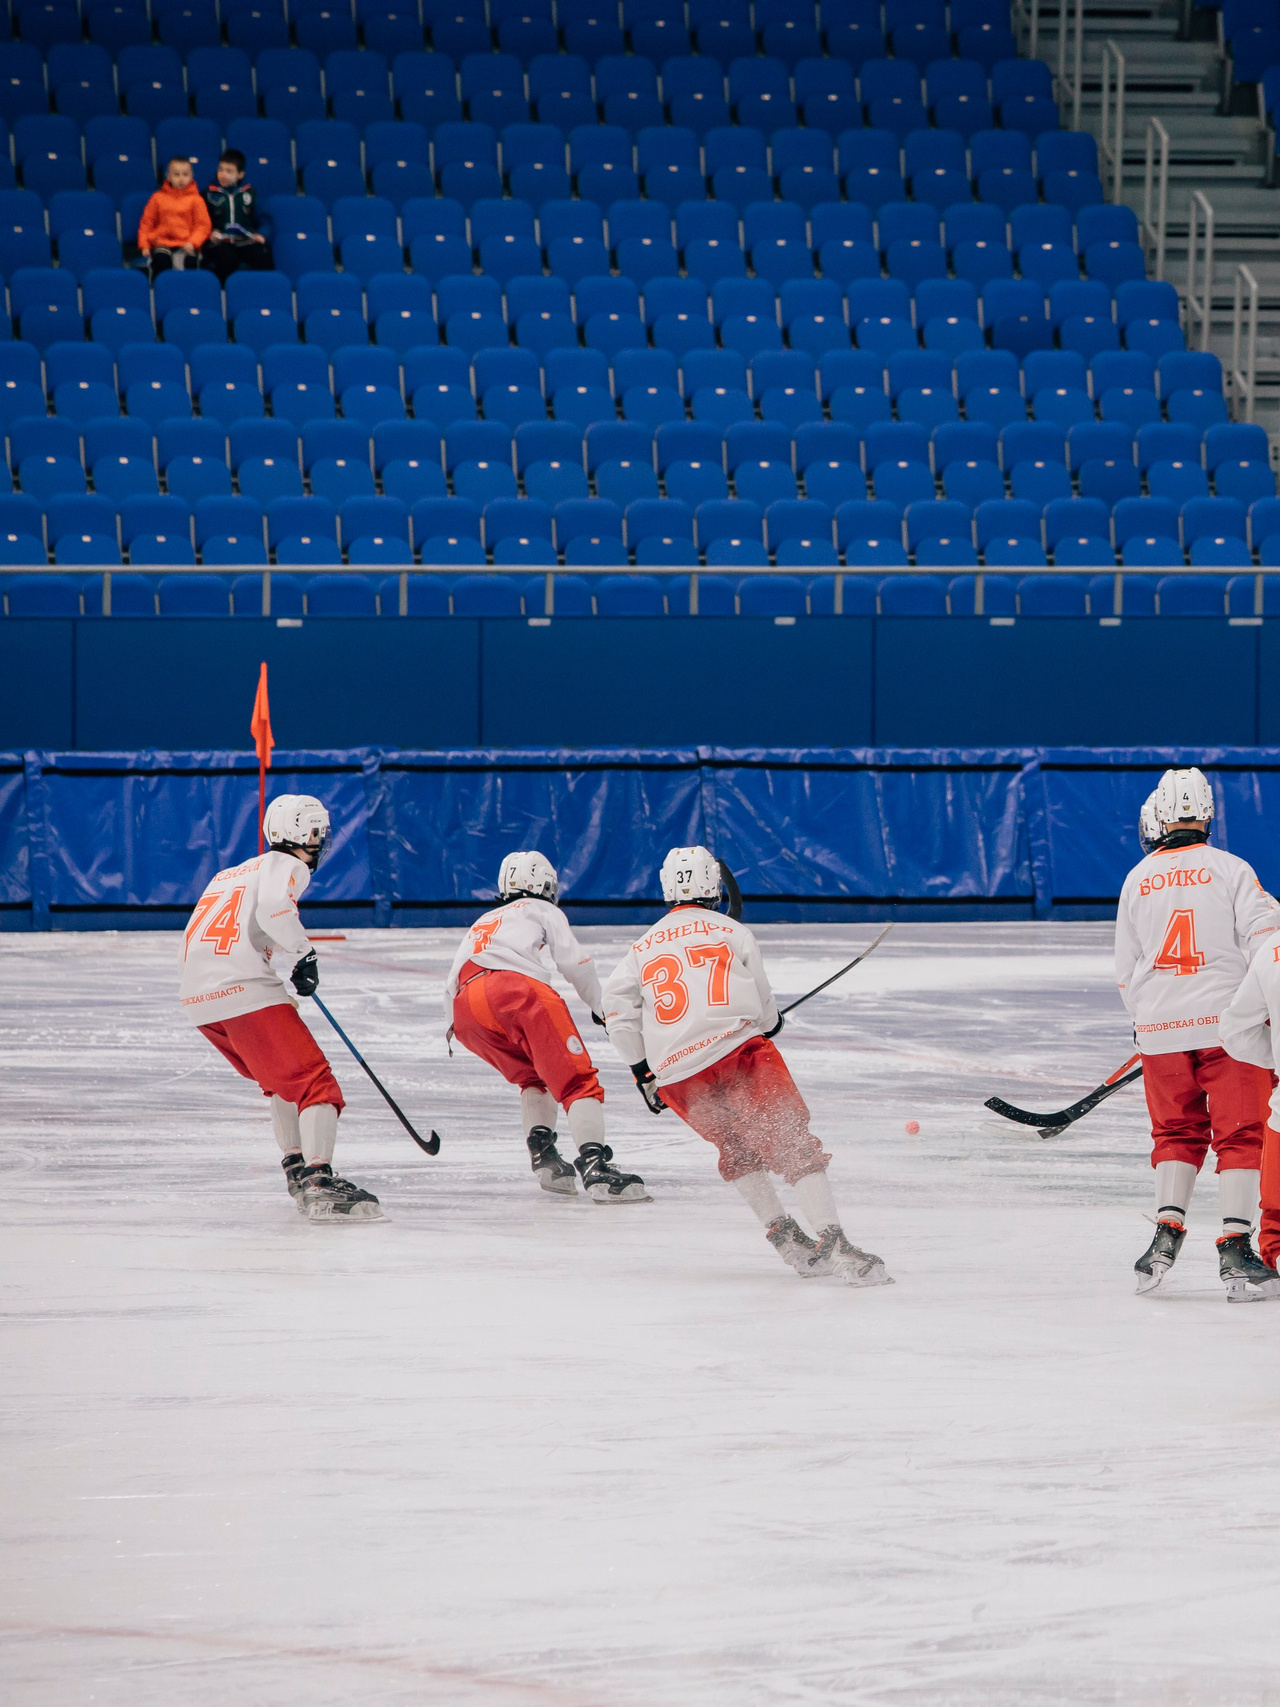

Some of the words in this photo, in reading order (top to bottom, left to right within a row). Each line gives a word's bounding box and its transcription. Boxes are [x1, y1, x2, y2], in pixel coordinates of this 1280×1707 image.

[1182, 792, 1190, 801] 4
[510, 867, 517, 879] 7
[676, 869, 693, 884] 37
[1139, 866, 1213, 897] БОЙКО
[184, 886, 247, 963] 74
[1153, 909, 1206, 977] 4
[205, 984, 245, 1002] ОБЛАСТЬ
[641, 941, 735, 1025] 37
